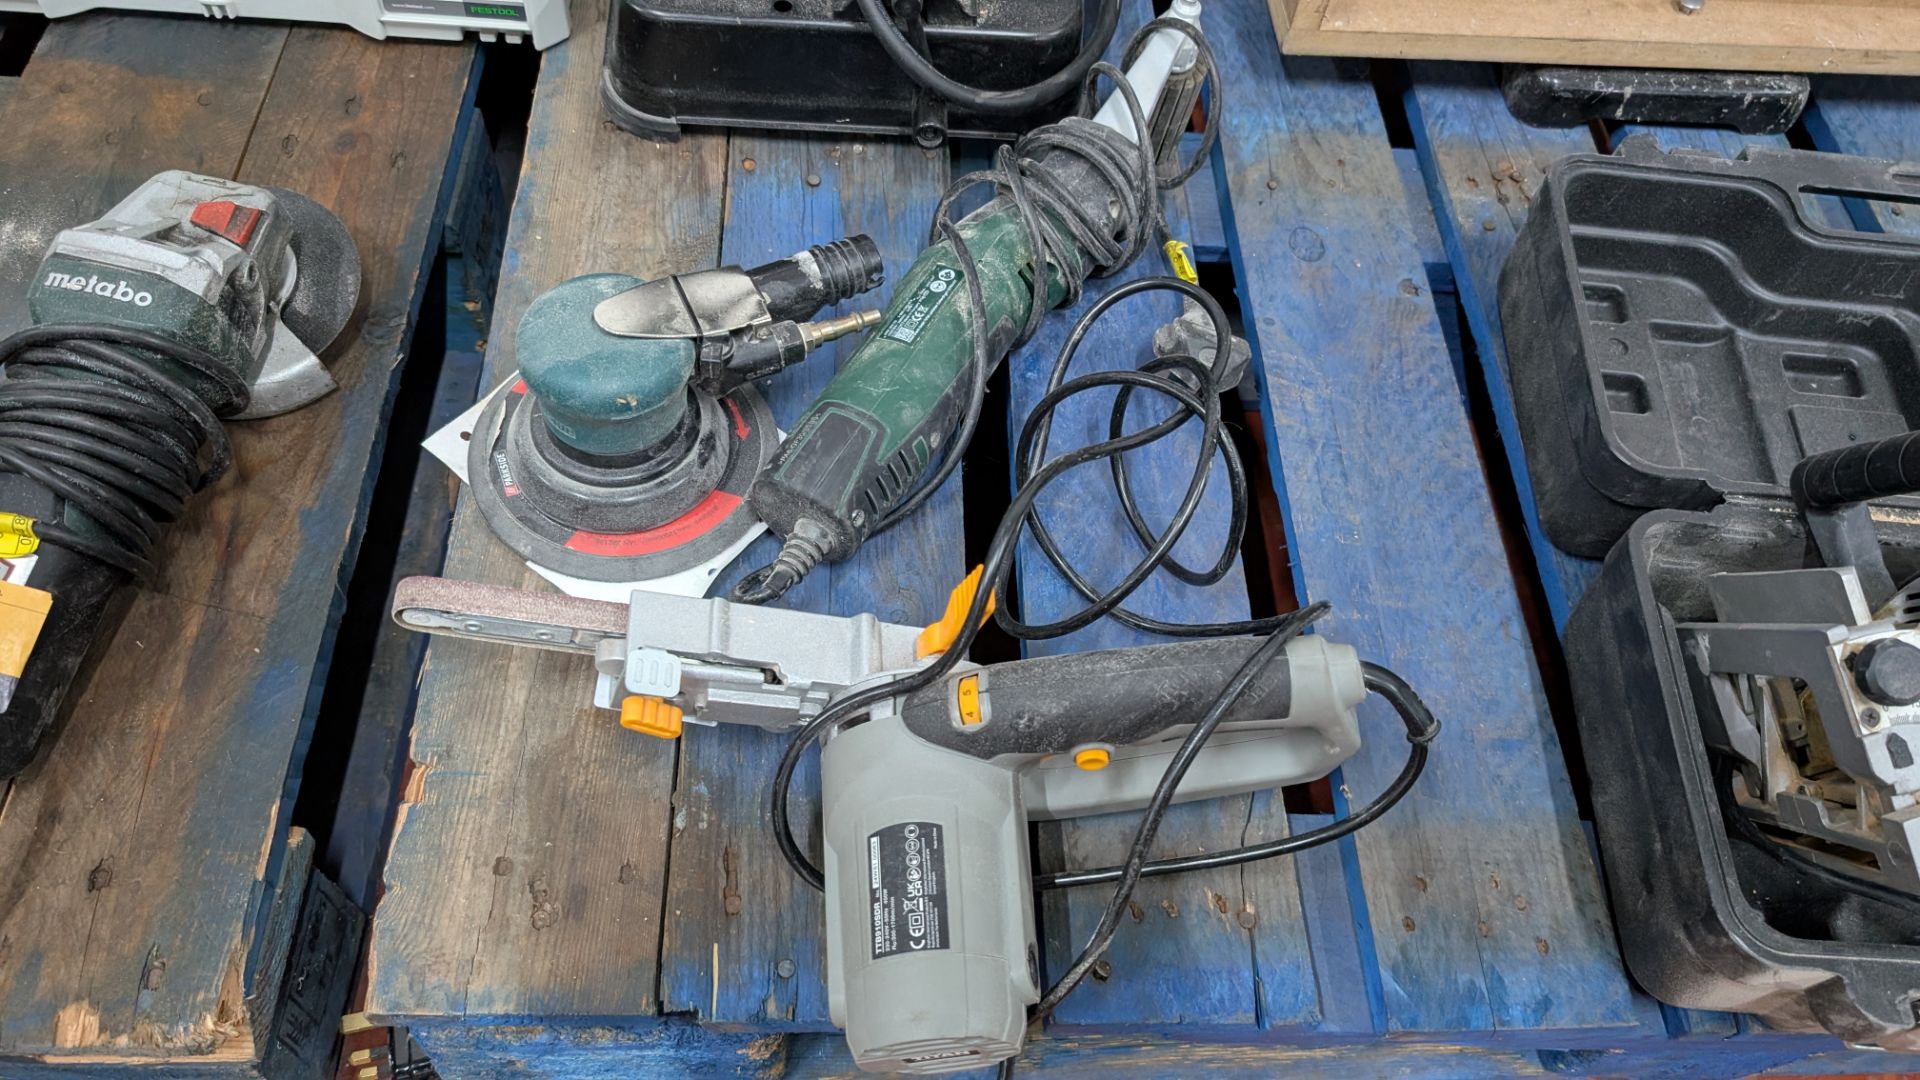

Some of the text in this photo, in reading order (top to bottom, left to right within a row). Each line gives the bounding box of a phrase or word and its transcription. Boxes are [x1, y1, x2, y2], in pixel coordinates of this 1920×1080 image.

[470, 6, 519, 17] FESTOOL
[44, 272, 153, 307] metabo
[496, 453, 513, 486] PARKSIDE
[873, 901, 883, 955] TTB910SDR
